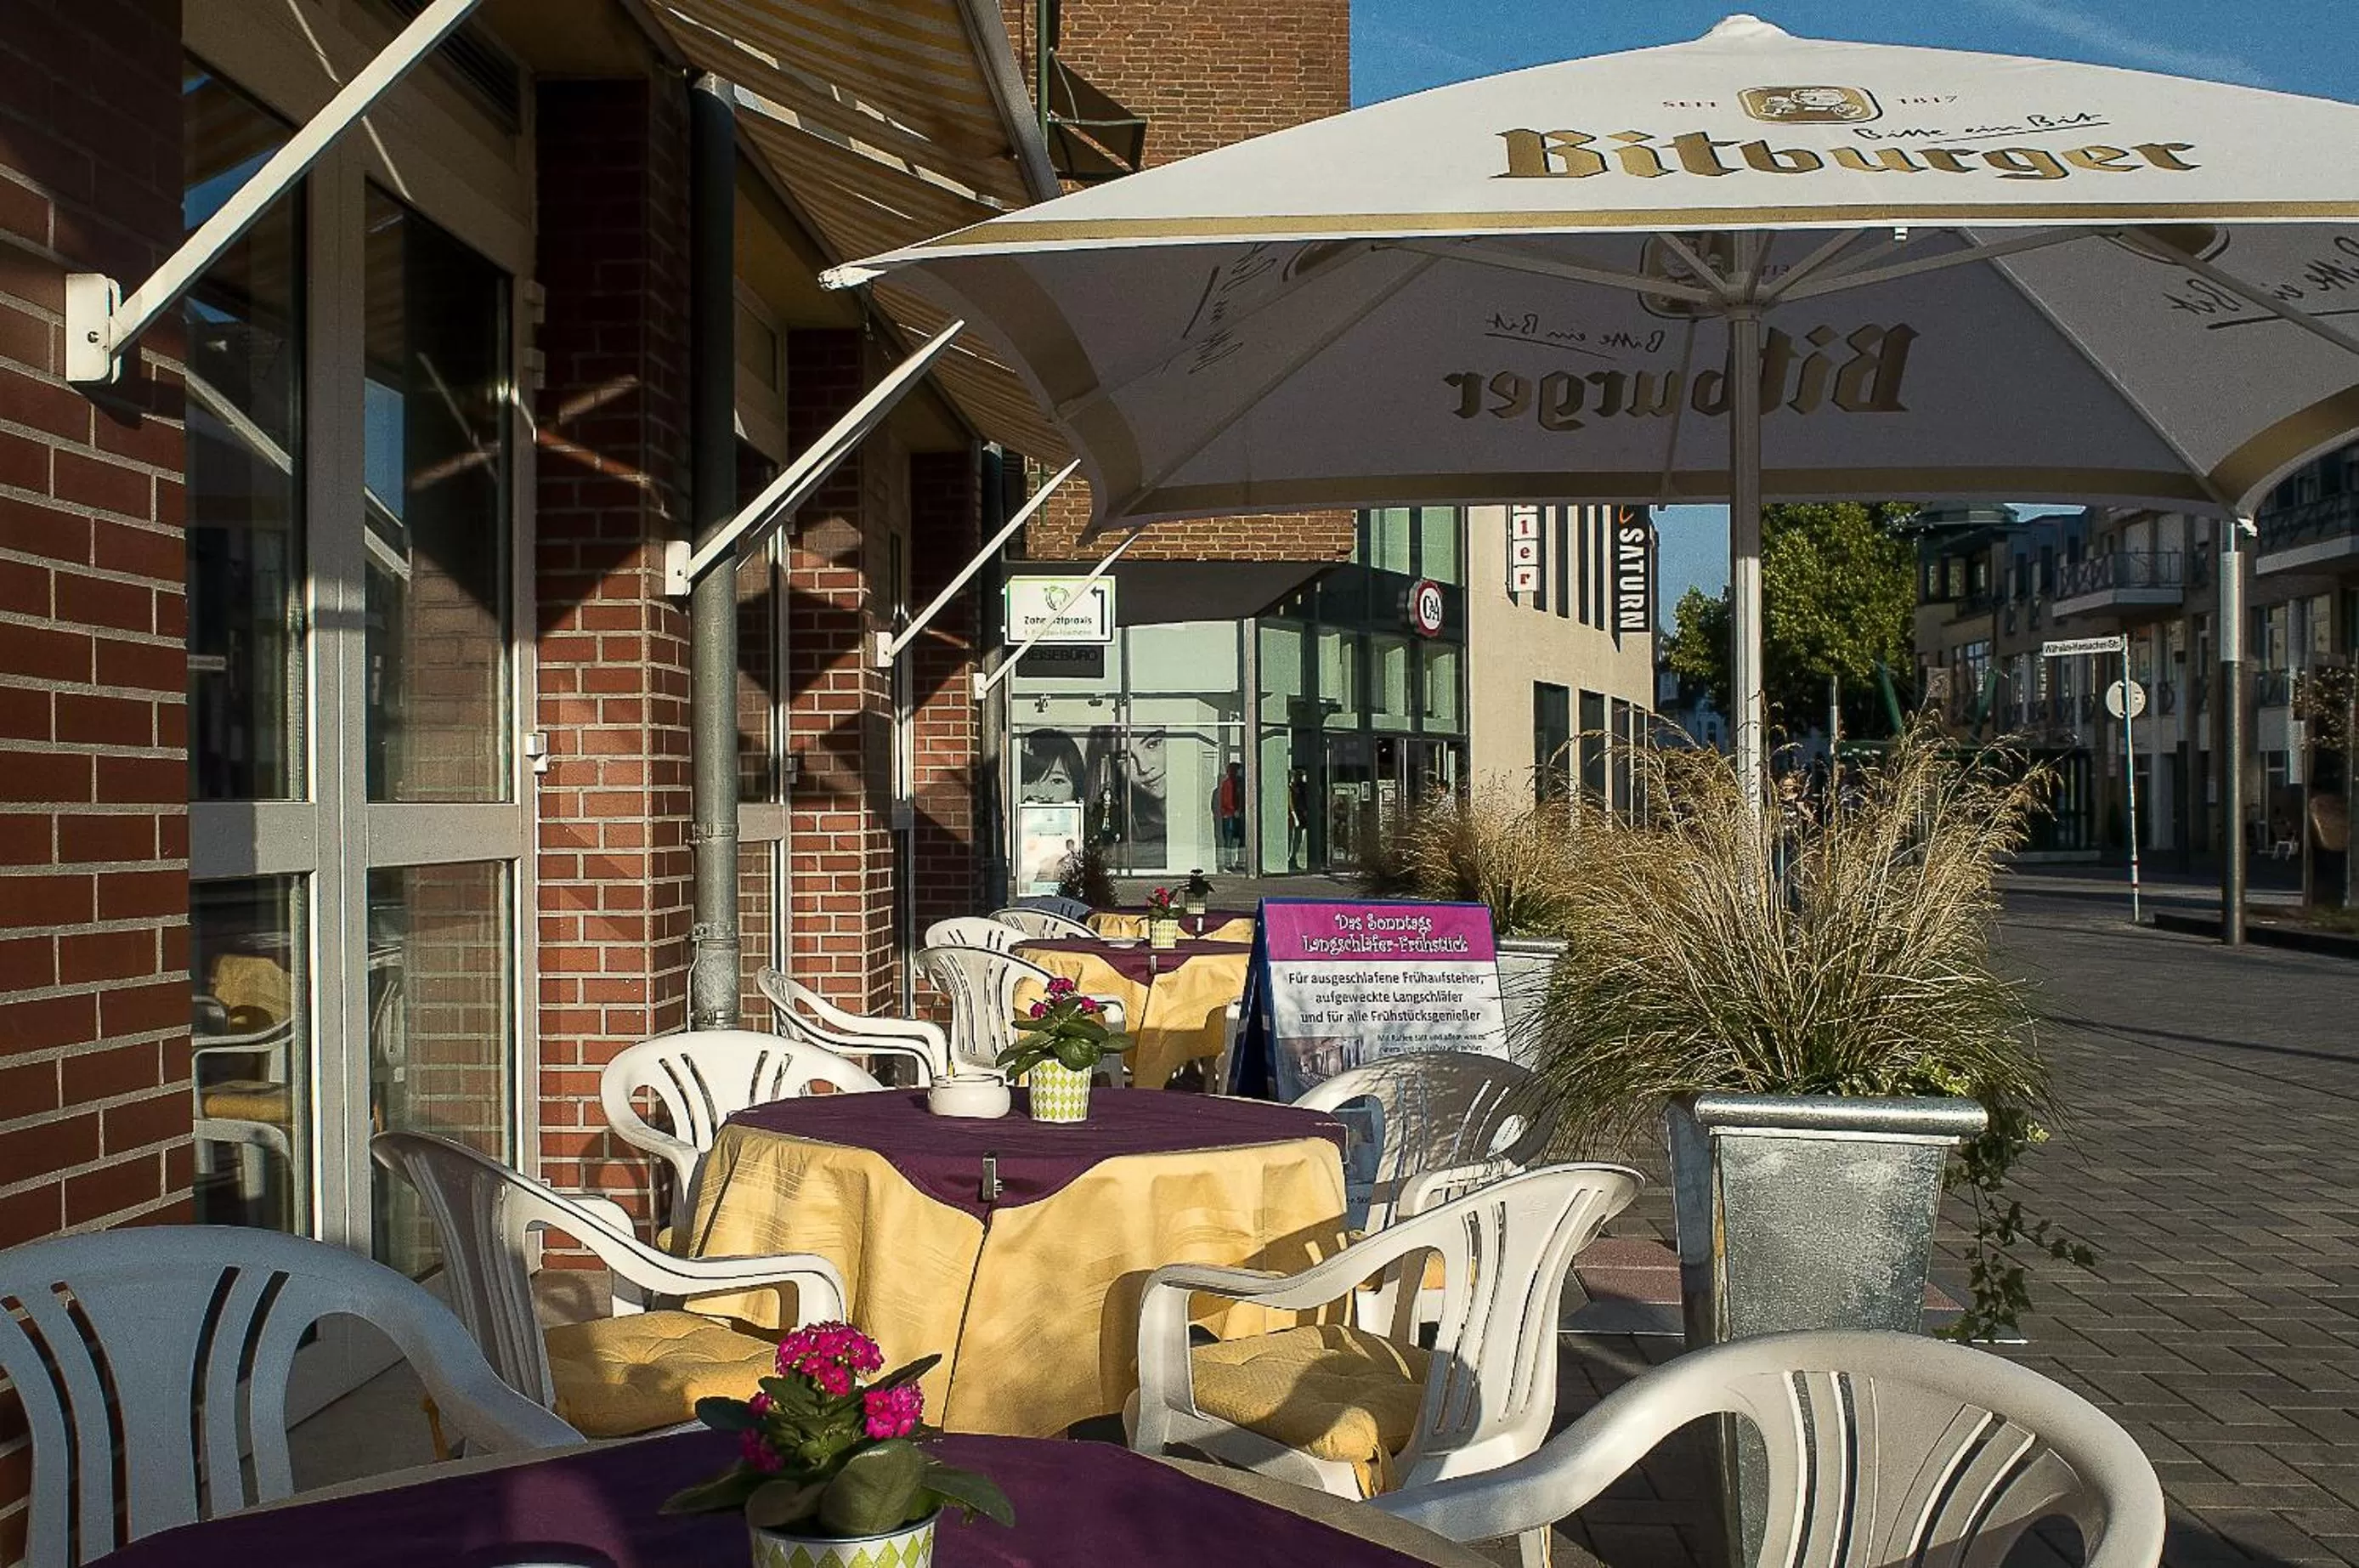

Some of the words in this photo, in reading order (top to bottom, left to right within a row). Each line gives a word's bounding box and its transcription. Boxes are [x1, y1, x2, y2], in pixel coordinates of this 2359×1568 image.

[1662, 99, 1719, 109] SEIT
[1896, 95, 1960, 105] 1817
[1853, 127, 1949, 141] Bitte
[1965, 124, 2022, 135] ein
[2027, 111, 2103, 128] Bit
[1489, 127, 2201, 180] Bitburger
[1619, 527, 1646, 629] SATURN
[1423, 595, 1440, 622] C&A
[1024, 615, 1093, 626] Zahnrztpraxis
[1334, 914, 1362, 931] Das
[1366, 914, 1433, 934] Sonntags
[1303, 934, 1469, 955] Langschläfer-Frühstück
[1288, 971, 1309, 984] Für
[1310, 971, 1400, 986] ausgeschlafene
[1402, 971, 1484, 984] Frühaufsteher,
[1315, 990, 1390, 1005] aufgeweckte
[1393, 990, 1463, 1005] Langschläfer
[1300, 1010, 1323, 1023] und
[1327, 1010, 1344, 1023] für
[1347, 1009, 1369, 1022] alle
[1371, 1009, 1481, 1023] Frühstücksgenießer
